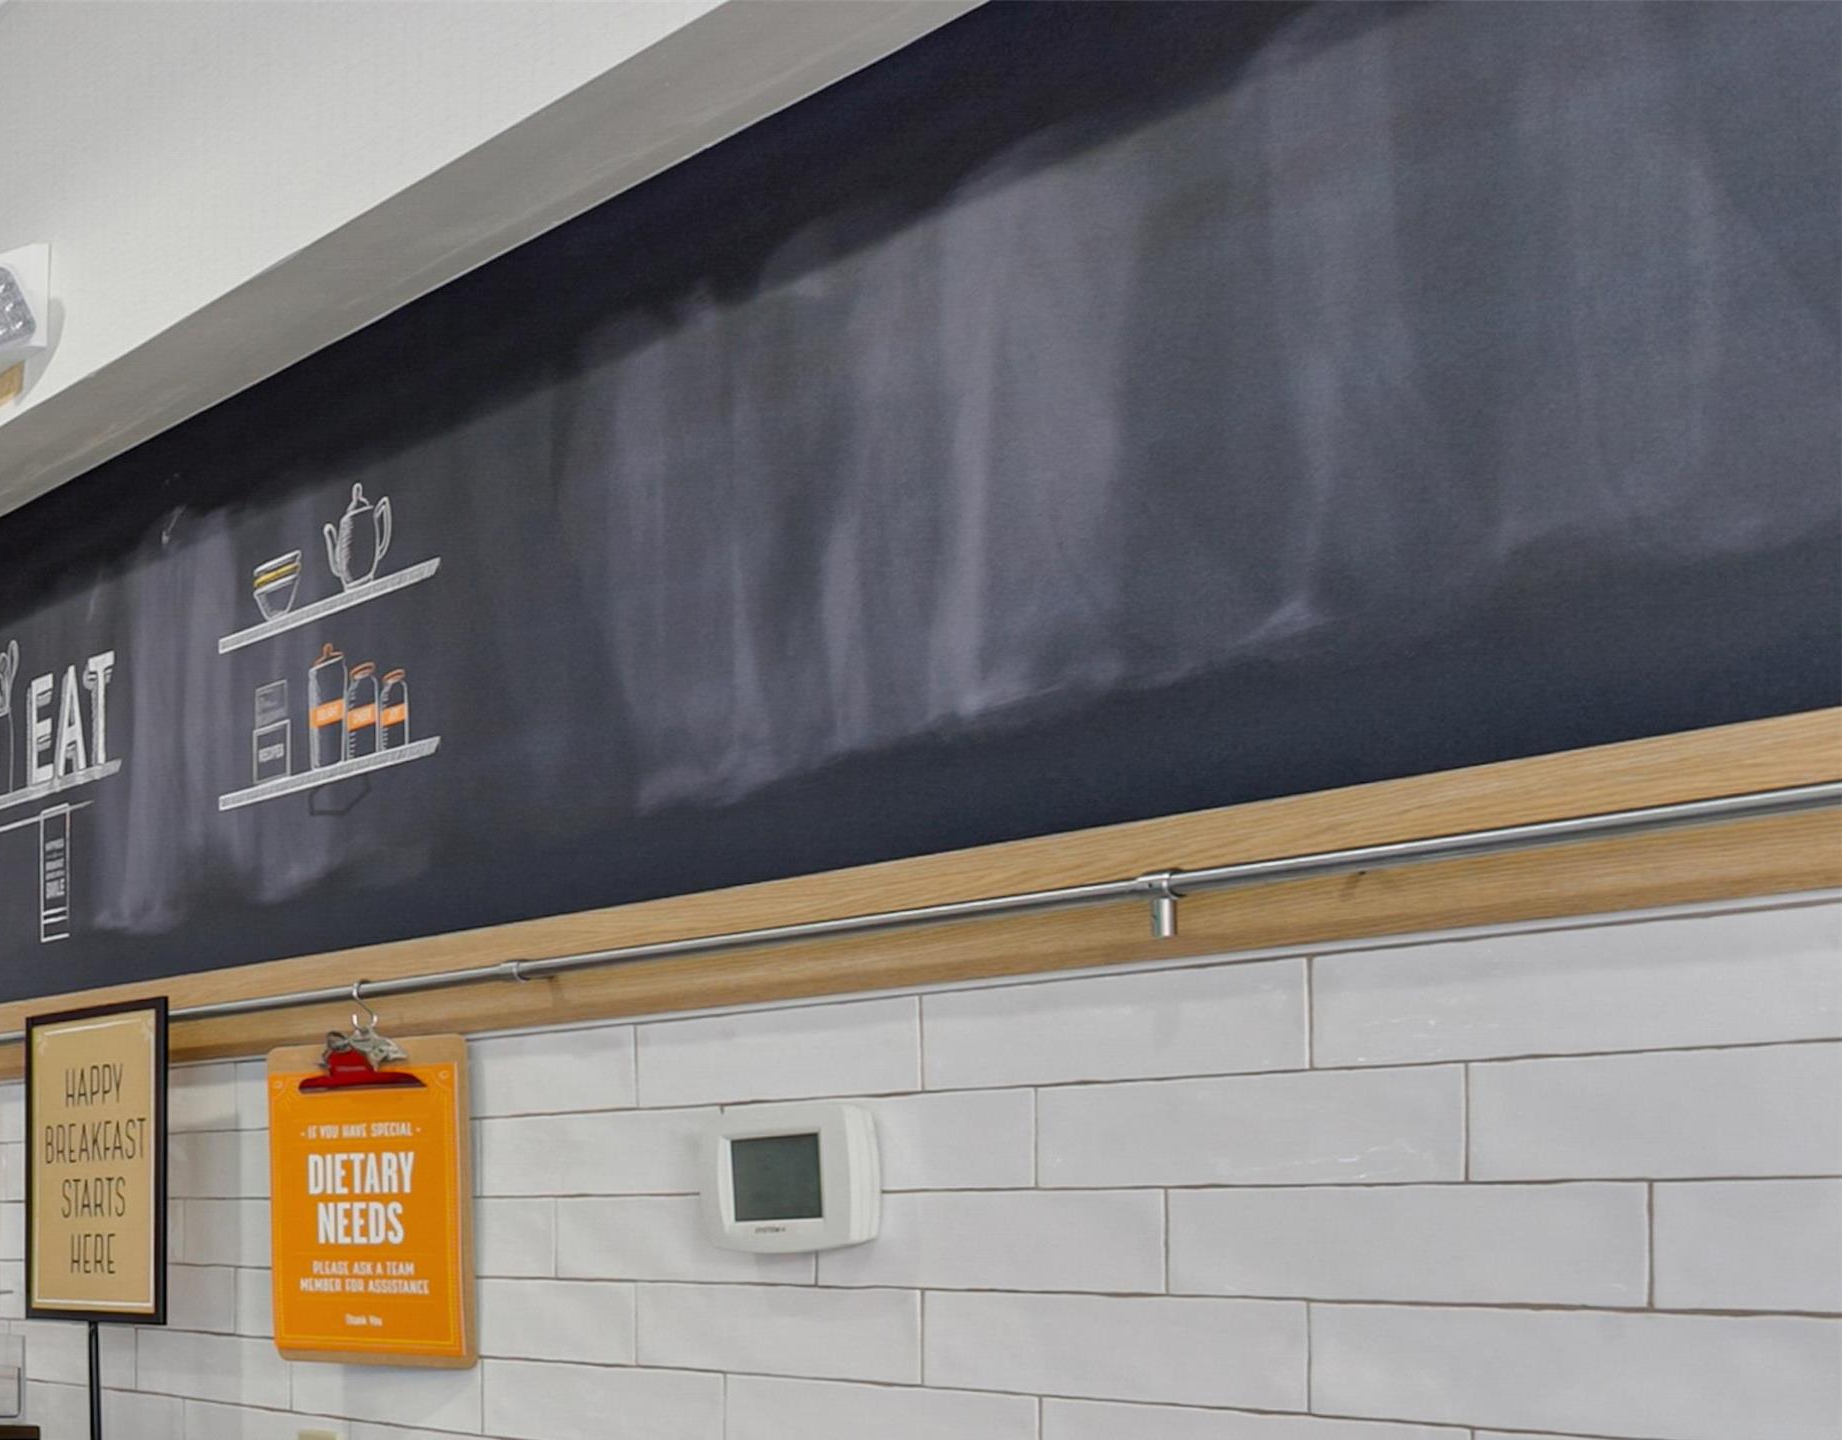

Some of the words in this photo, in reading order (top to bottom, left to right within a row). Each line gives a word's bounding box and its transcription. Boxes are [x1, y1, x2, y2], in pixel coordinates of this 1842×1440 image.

[26, 650, 114, 786] EAT
[65, 1063, 124, 1108] HAPPY
[45, 1117, 147, 1164] BREAKFAST
[307, 1124, 317, 1139] IF
[319, 1124, 339, 1139] YOU
[342, 1123, 367, 1138] HAVE
[371, 1122, 413, 1137] SPECIAL
[308, 1151, 414, 1195] DIETARY
[61, 1176, 126, 1218] STARTS
[317, 1201, 405, 1244] NEEDS
[70, 1234, 116, 1274] HERE
[312, 1260, 349, 1275] PLEASE
[352, 1261, 373, 1276] ASK
[375, 1261, 383, 1276] A
[386, 1261, 414, 1276] TEAM
[299, 1277, 342, 1292] MEMBER
[345, 1278, 364, 1292] FOR
[367, 1279, 429, 1295] ASSISTANCE
